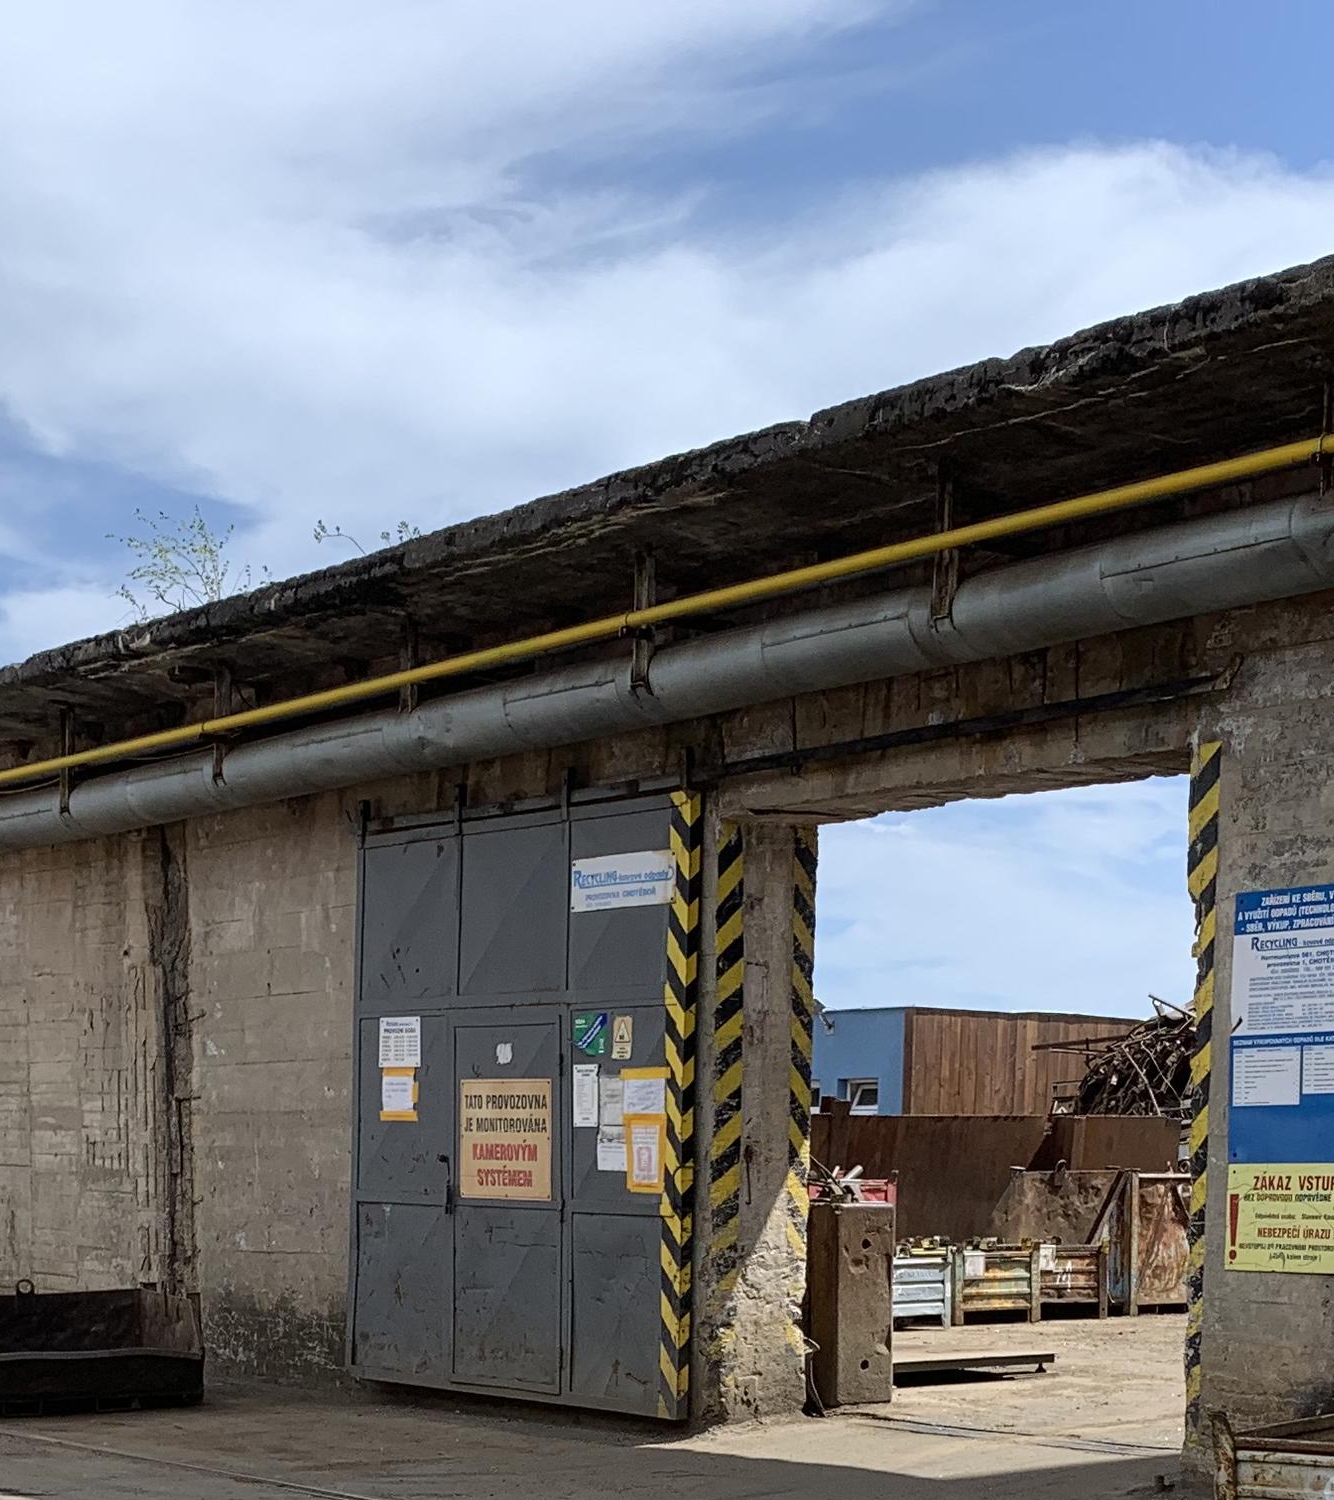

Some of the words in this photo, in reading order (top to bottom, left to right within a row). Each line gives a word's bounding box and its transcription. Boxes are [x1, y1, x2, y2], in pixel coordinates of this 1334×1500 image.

[1292, 894, 1301, 904] KE
[1251, 936, 1298, 951] RECYCLING
[465, 1094, 483, 1110] TATO
[486, 1094, 547, 1110] PROVOZOVNA
[465, 1118, 473, 1132] JE
[477, 1114, 547, 1133] MONITOROVÁNA
[473, 1139, 538, 1162] KAMEROVÝM
[477, 1165, 533, 1188] SYSTÉMEM
[1253, 1171, 1292, 1191] ZÁKAZ
[1257, 1225, 1301, 1239] NEBEZPEČÍ
[1303, 1226, 1331, 1240] ÚRAZU
